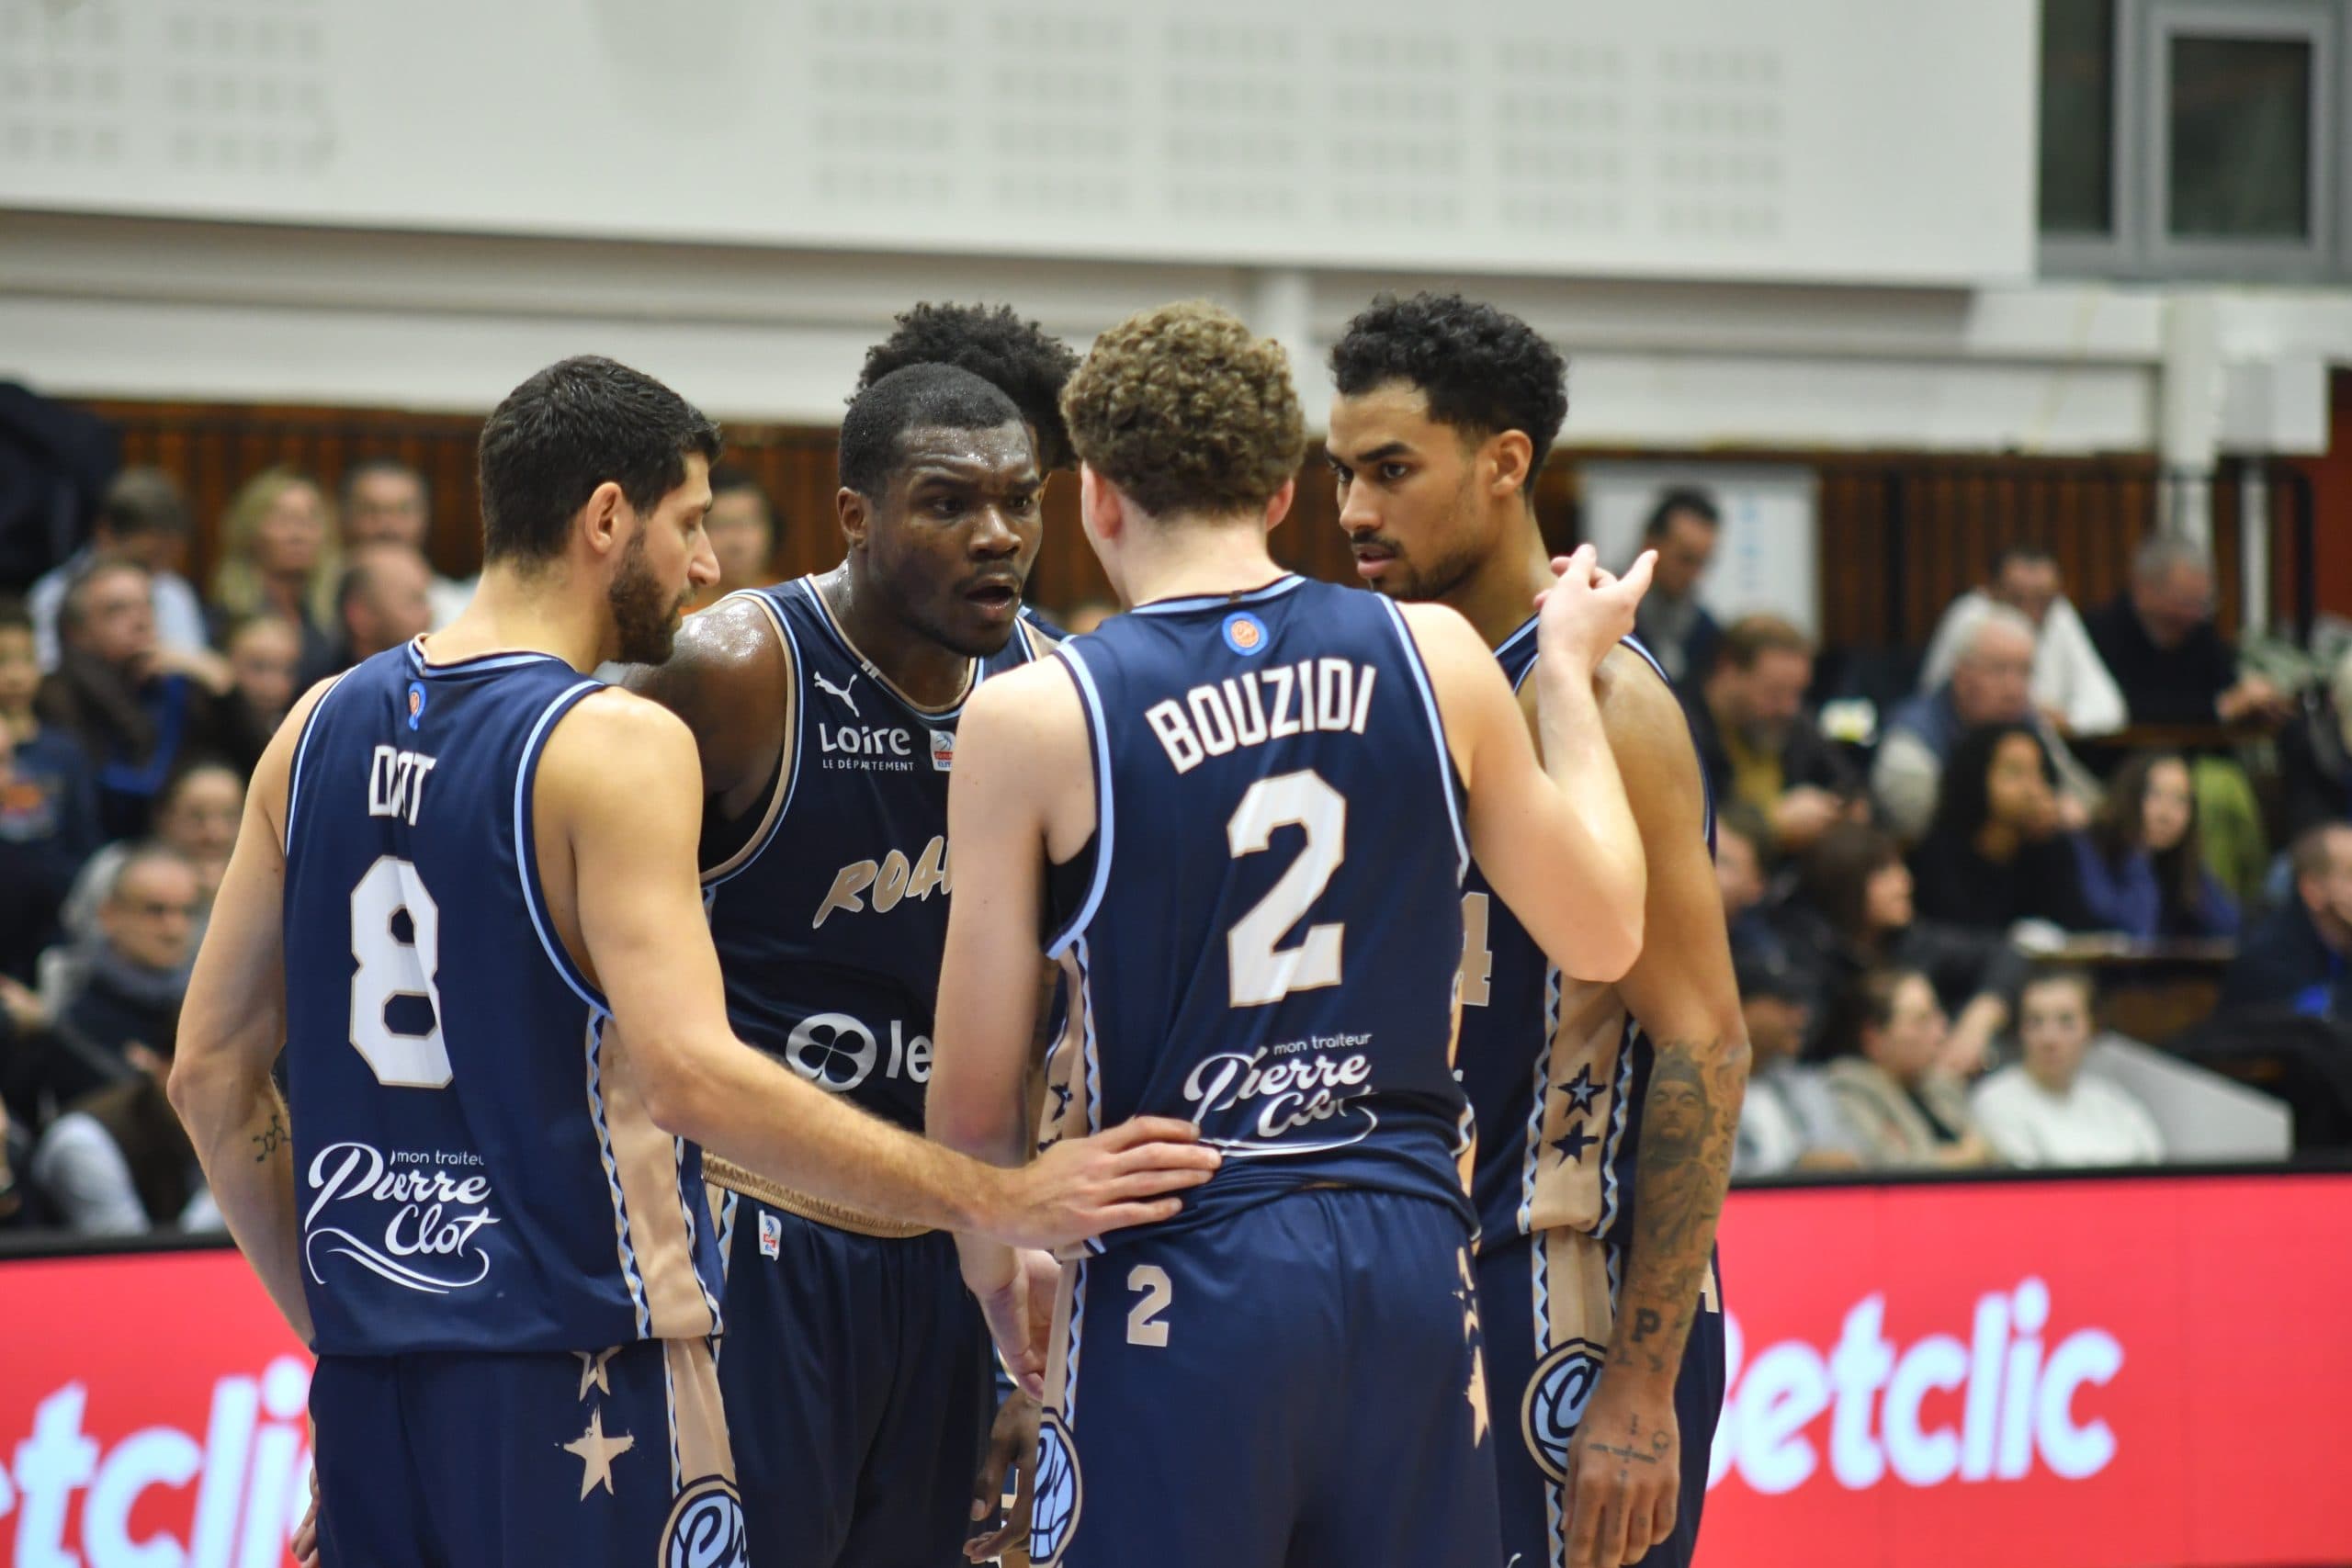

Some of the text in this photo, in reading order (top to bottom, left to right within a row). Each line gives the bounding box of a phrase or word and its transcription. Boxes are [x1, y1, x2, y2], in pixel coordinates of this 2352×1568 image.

[819, 722, 911, 755] Loire
[1145, 658, 1376, 774] BOUZIDI
[822, 759, 834, 769] LE
[813, 835, 953, 930] ROA
[1227, 769, 1346, 1008] 2
[349, 854, 454, 1089] 8
[1274, 1032, 1373, 1055] mon traiteur
[1183, 1046, 1372, 1126] Pierre
[397, 1152, 430, 1164] mon
[384, 1203, 502, 1258] Clot
[1126, 1264, 1172, 1348] 2
[0, 1355, 314, 1568] tcli
